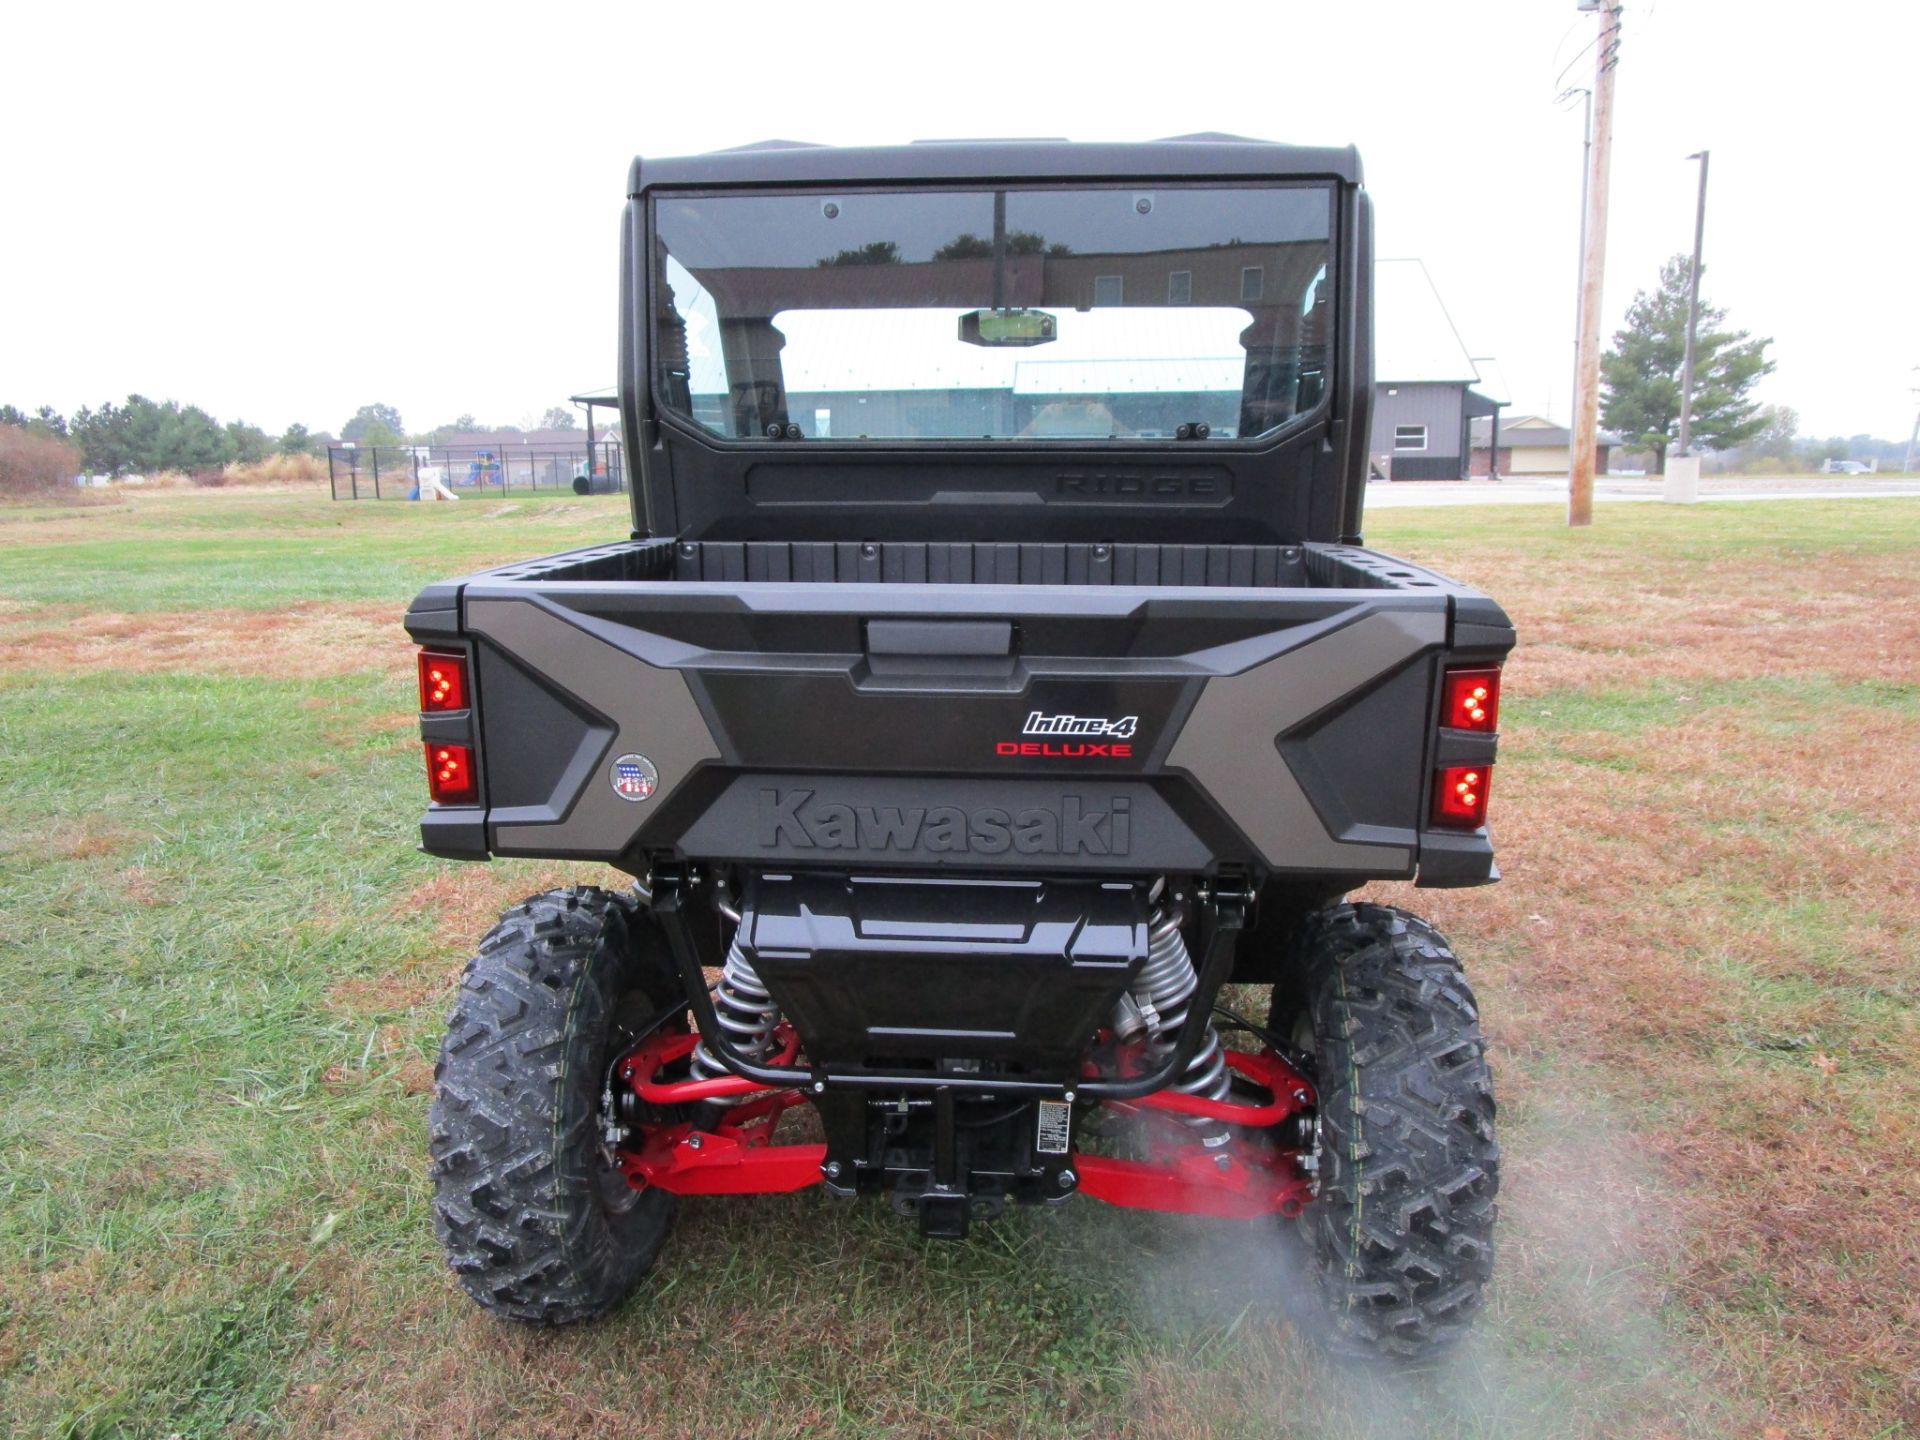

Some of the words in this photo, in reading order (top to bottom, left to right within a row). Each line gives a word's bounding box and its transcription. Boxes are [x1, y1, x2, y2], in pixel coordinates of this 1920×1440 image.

[1056, 473, 1216, 494] RIDGE
[1022, 711, 1138, 738] Inline-4
[996, 742, 1132, 757] DELUXE
[759, 788, 1131, 856] Kawasaki
